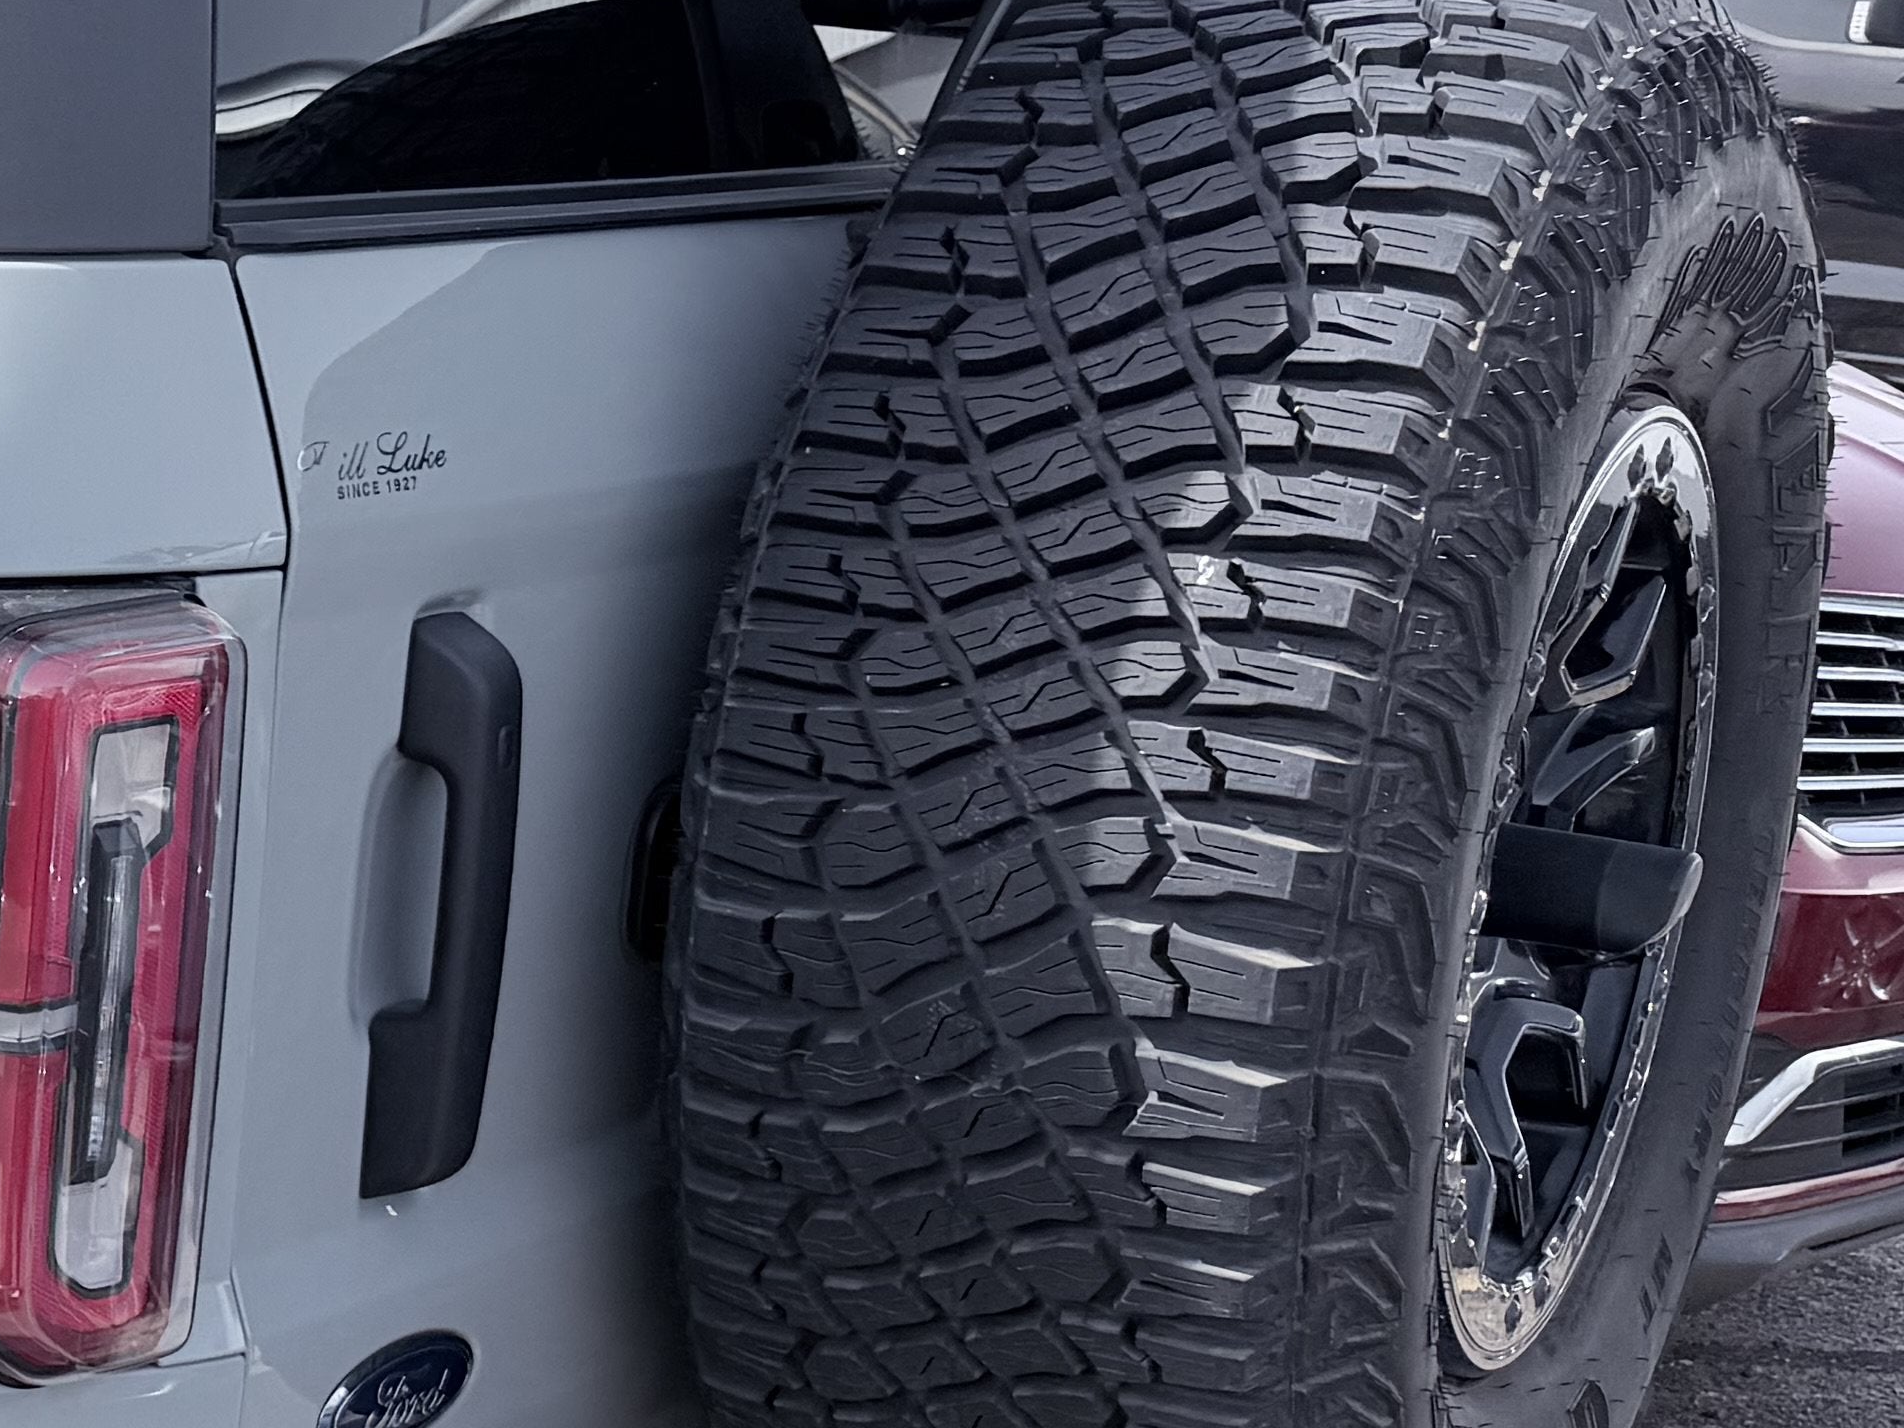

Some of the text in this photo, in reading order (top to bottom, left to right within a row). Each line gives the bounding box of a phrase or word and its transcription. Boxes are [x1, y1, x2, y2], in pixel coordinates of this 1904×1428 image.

[376, 431, 447, 475] Luke
[336, 475, 418, 500] SINCE 1927
